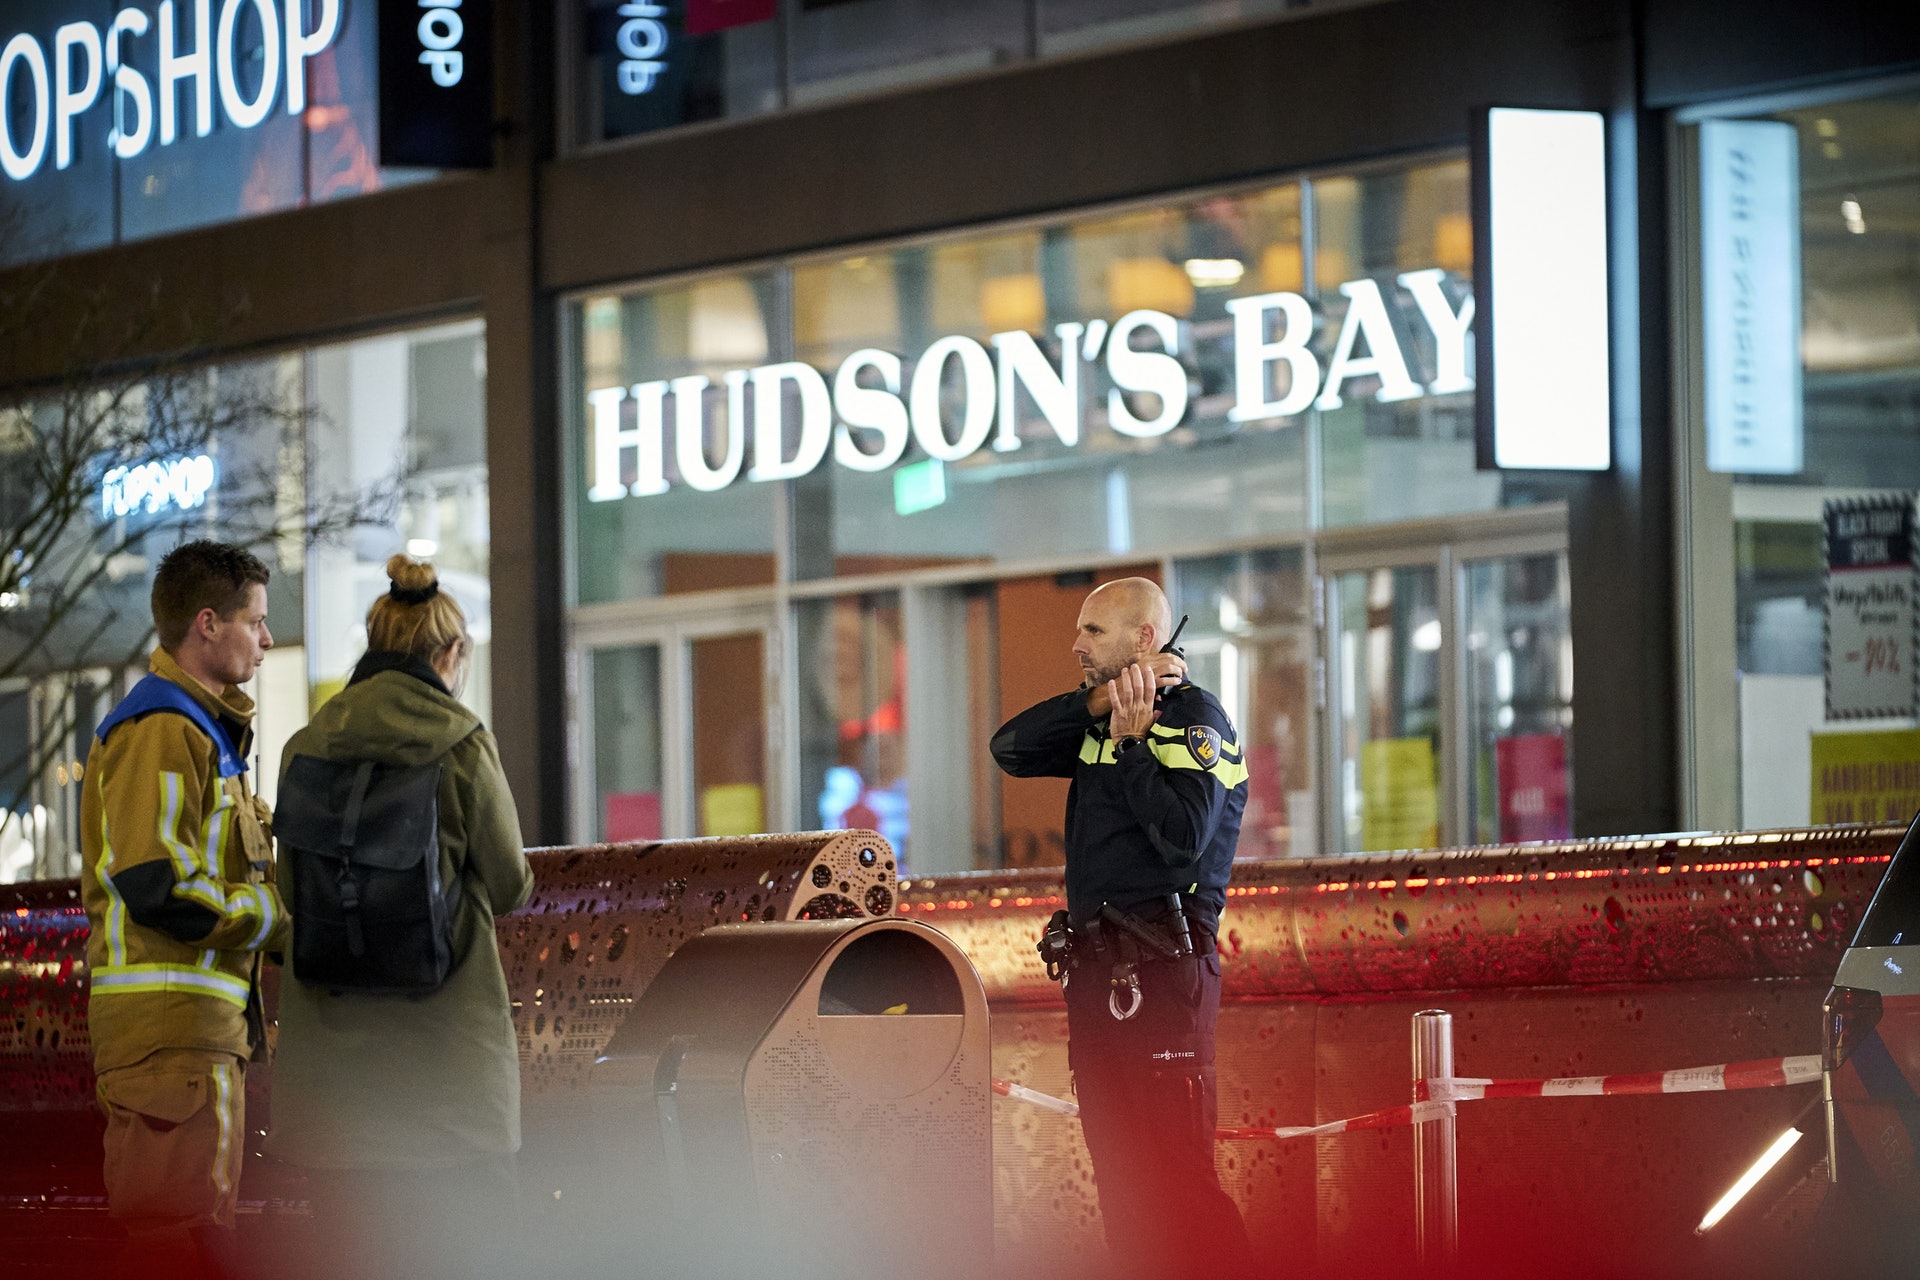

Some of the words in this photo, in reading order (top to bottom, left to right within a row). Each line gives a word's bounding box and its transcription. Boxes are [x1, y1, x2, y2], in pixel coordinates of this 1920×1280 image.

[417, 0, 464, 88] OP
[587, 310, 1188, 502] HUDSON'S
[1225, 268, 1476, 423] BAY
